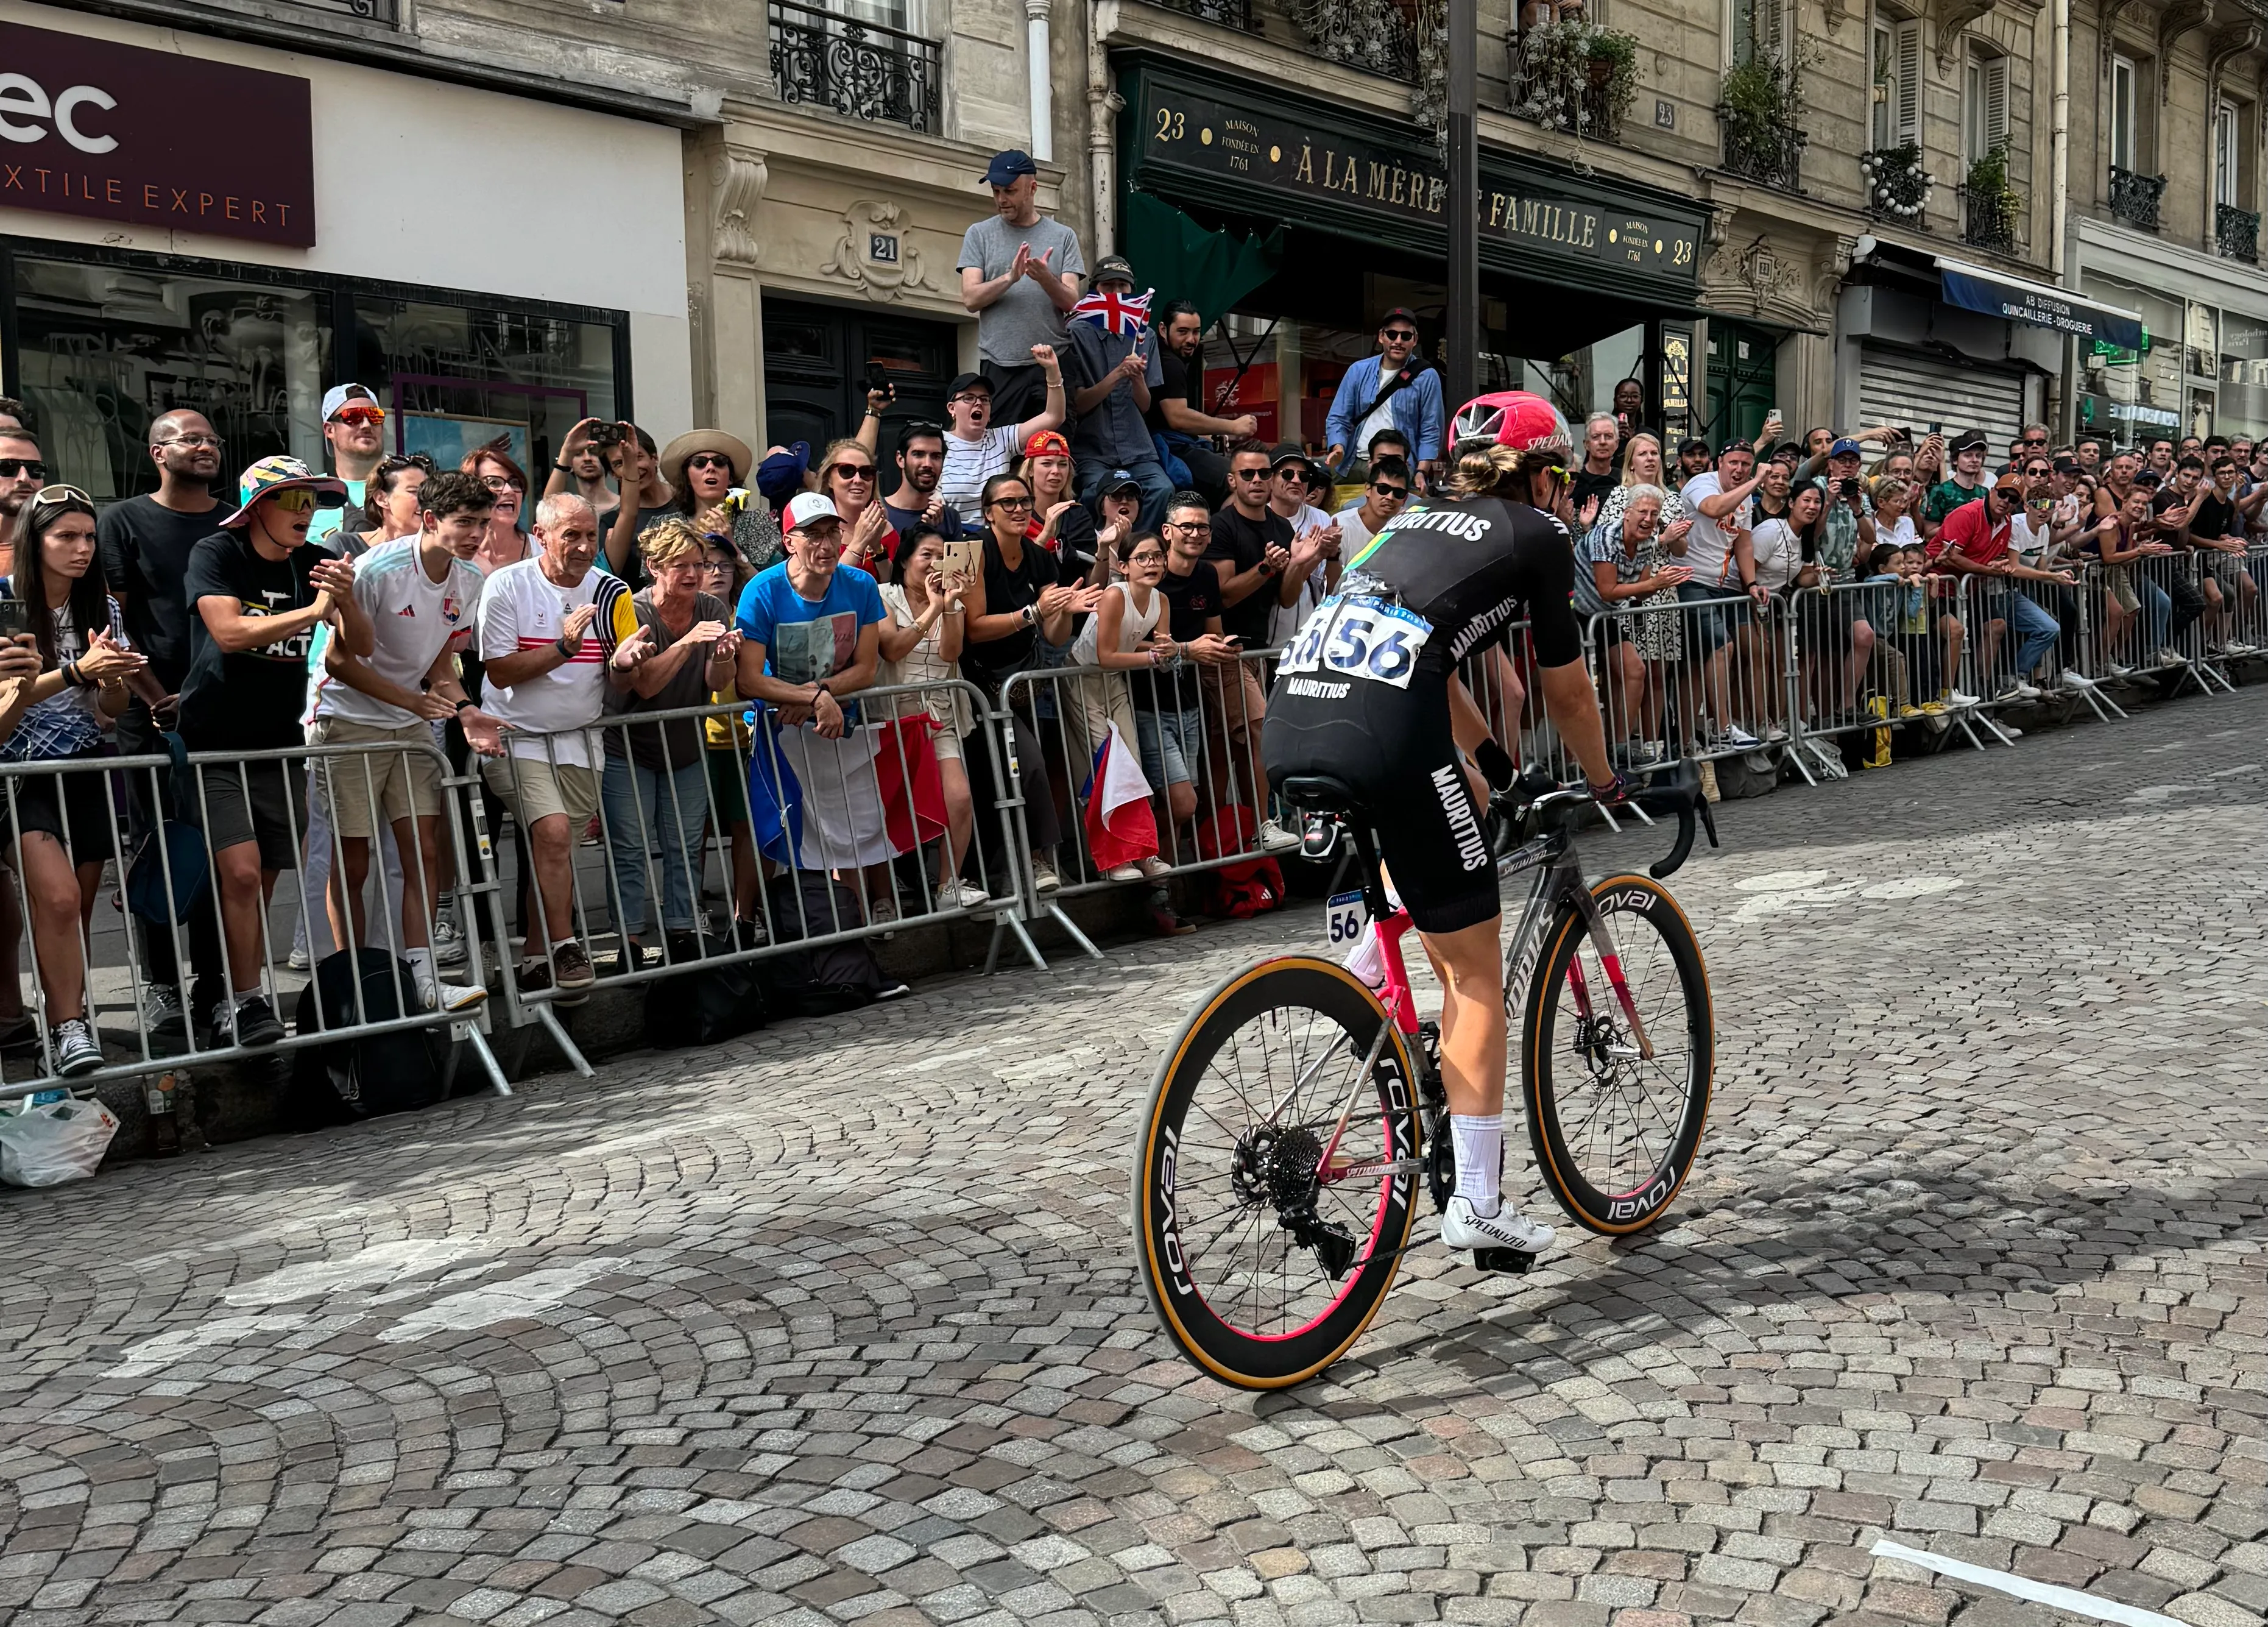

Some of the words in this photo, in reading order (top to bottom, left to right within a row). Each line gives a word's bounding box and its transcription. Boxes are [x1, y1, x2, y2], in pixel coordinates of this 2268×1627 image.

[1155, 108, 1185, 142] 23
[1226, 120, 1259, 138] MAISON
[1659, 103, 1672, 124] 23
[1222, 136, 1249, 152] FONDÉE
[1250, 144, 1260, 154] EN
[1230, 155, 1248, 171] 1761
[144, 184, 291, 227] EXPERT
[1295, 136, 1314, 184] À
[1323, 150, 1359, 194] LA
[1366, 158, 1443, 213] MÈRE
[1489, 192, 1597, 249] FAMILLE
[1626, 221, 1649, 234] MAISON
[874, 237, 896, 260] 21
[1627, 250, 1641, 261] 1761
[1672, 239, 1692, 265] 23
[2002, 303, 2052, 325] QUINCAILLERIE
[2057, 316, 2093, 335] DROGUERIE
[2026, 295, 2035, 306] AB
[2038, 297, 2070, 316] DIFFUSION
[1450, 595, 1518, 662] MAURITIUS
[1328, 618, 1411, 679] 56
[1287, 677, 1351, 699] MAURITIUS
[1430, 764, 1488, 871] MAURITIUS
[1597, 890, 1657, 916] oval
[1330, 909, 1359, 943] 56
[1379, 1057, 1411, 1211] roval
[1606, 1165, 1676, 1220] roval
[1160, 1125, 1194, 1296] roval
[1460, 1215, 1528, 1249] SPECIALIZED
